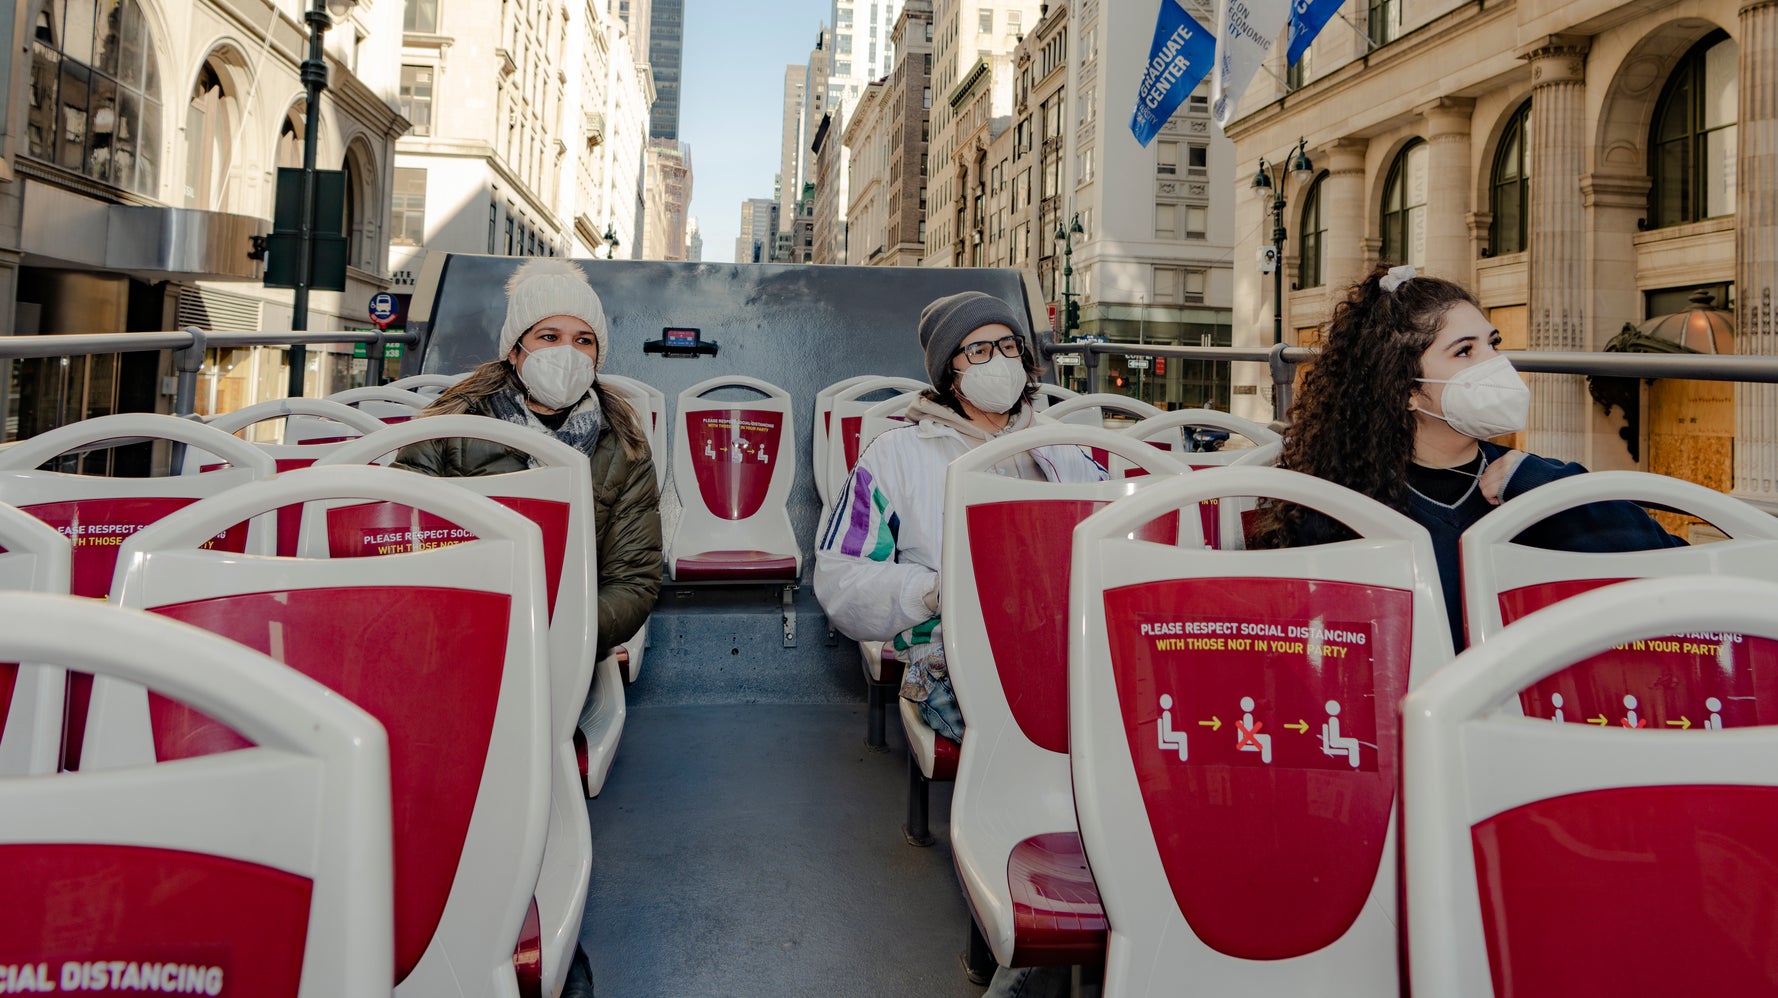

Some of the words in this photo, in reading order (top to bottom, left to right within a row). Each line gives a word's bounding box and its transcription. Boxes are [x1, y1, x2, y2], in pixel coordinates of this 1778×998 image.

[1236, 0, 1250, 19] ON
[1140, 24, 1193, 98] GRADUATE
[1145, 55, 1191, 109] CENTER
[57, 525, 86, 535] EASE
[88, 524, 135, 535] RESPECT
[364, 533, 402, 544] PLEASE
[405, 529, 449, 540] RESPECT
[450, 529, 475, 538] SOC
[89, 536, 122, 546] THOSE
[378, 545, 404, 555] WITH
[1141, 622, 1183, 636] PLEASE
[1185, 622, 1238, 635] RESPECT
[1240, 623, 1285, 637] SOCIAL
[1288, 626, 1366, 644] DISTANCING
[1156, 638, 1185, 651] WITH
[1187, 638, 1225, 650] THOSE
[1227, 639, 1252, 651] NOT
[1254, 639, 1268, 652] IN
[1270, 640, 1304, 654] YOUR
[1306, 643, 1348, 659] PARTY
[1632, 639, 1646, 651] IN
[1647, 640, 1681, 653] YOUR
[1683, 643, 1725, 656] PARTY
[60, 961, 223, 996] DISTANCING
